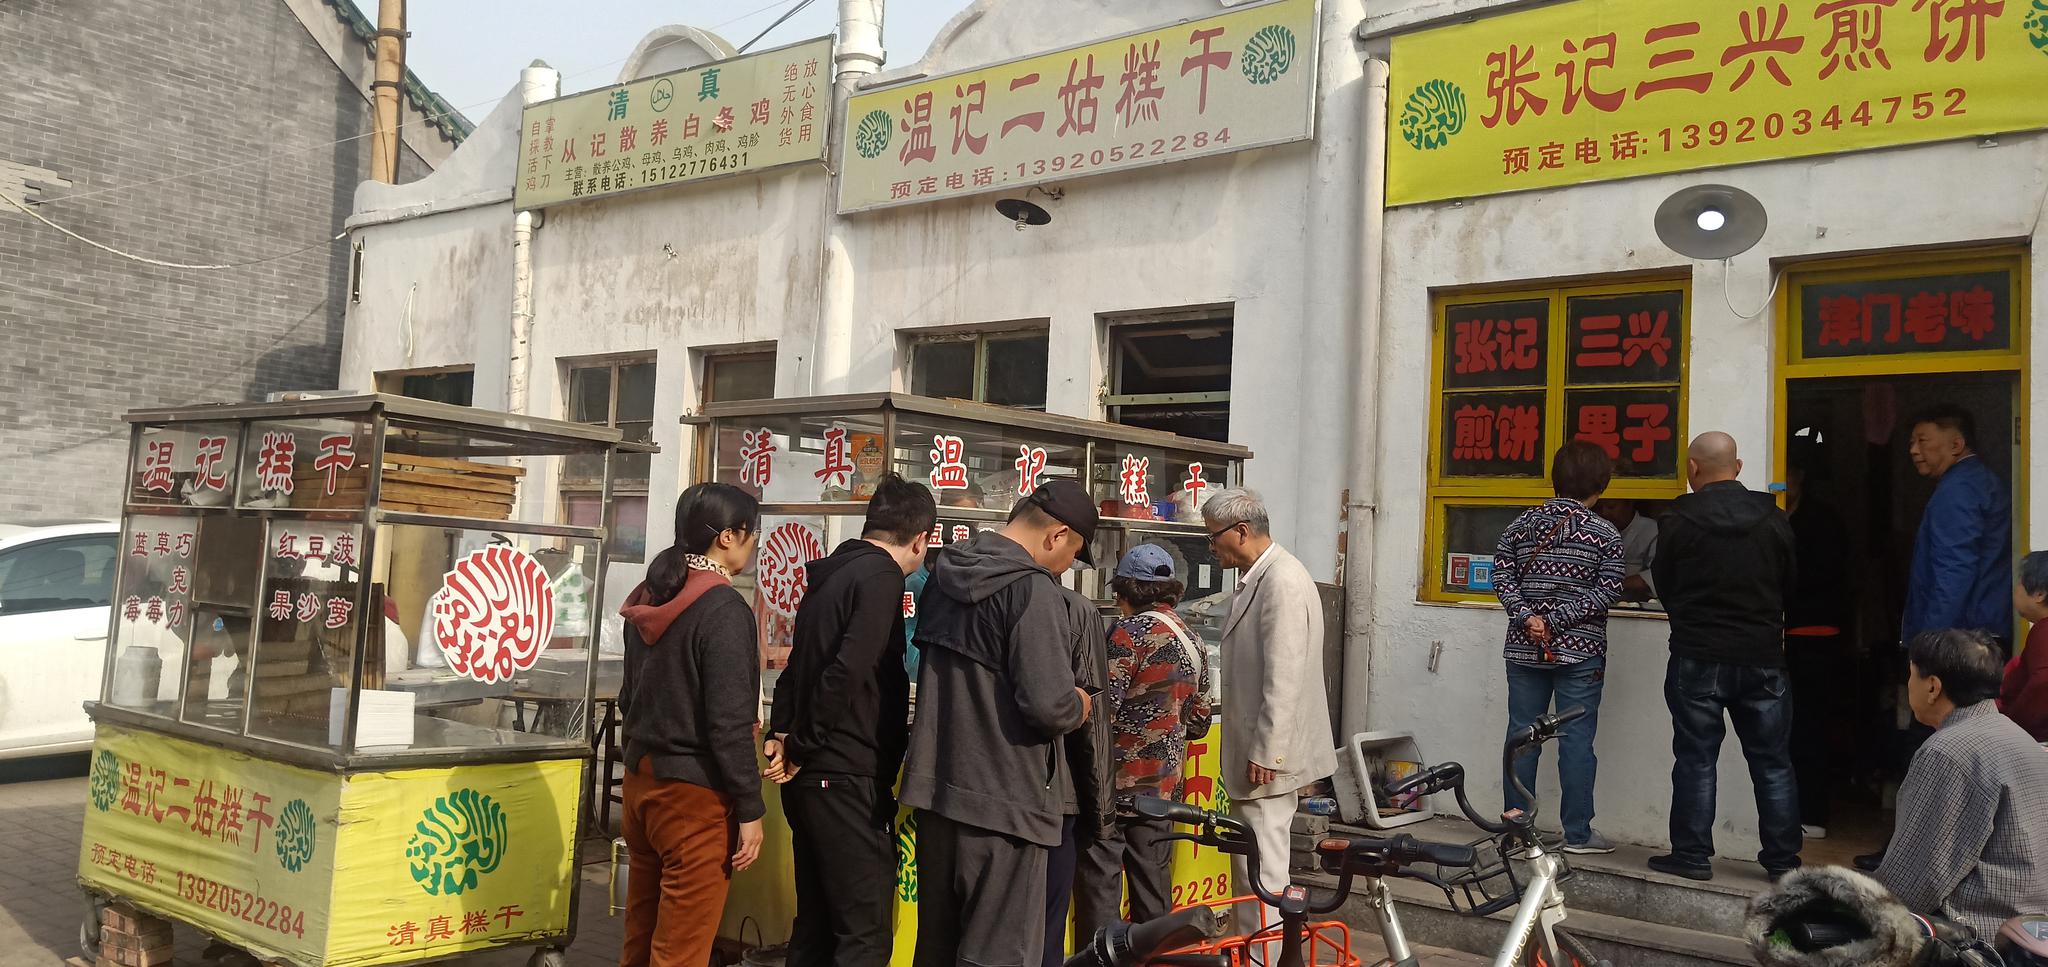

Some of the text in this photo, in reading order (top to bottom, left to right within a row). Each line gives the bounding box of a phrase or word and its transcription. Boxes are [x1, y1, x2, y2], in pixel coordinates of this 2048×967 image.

[778, 63, 798, 147] 绝无外货
[798, 58, 818, 144] 放心食用
[899, 27, 1232, 167] 温记二姑糕干
[1817, 285, 1996, 347] 津门老味
[120, 761, 274, 854] 温记二姑糕干
[387, 903, 525, 947] 清真糕干
